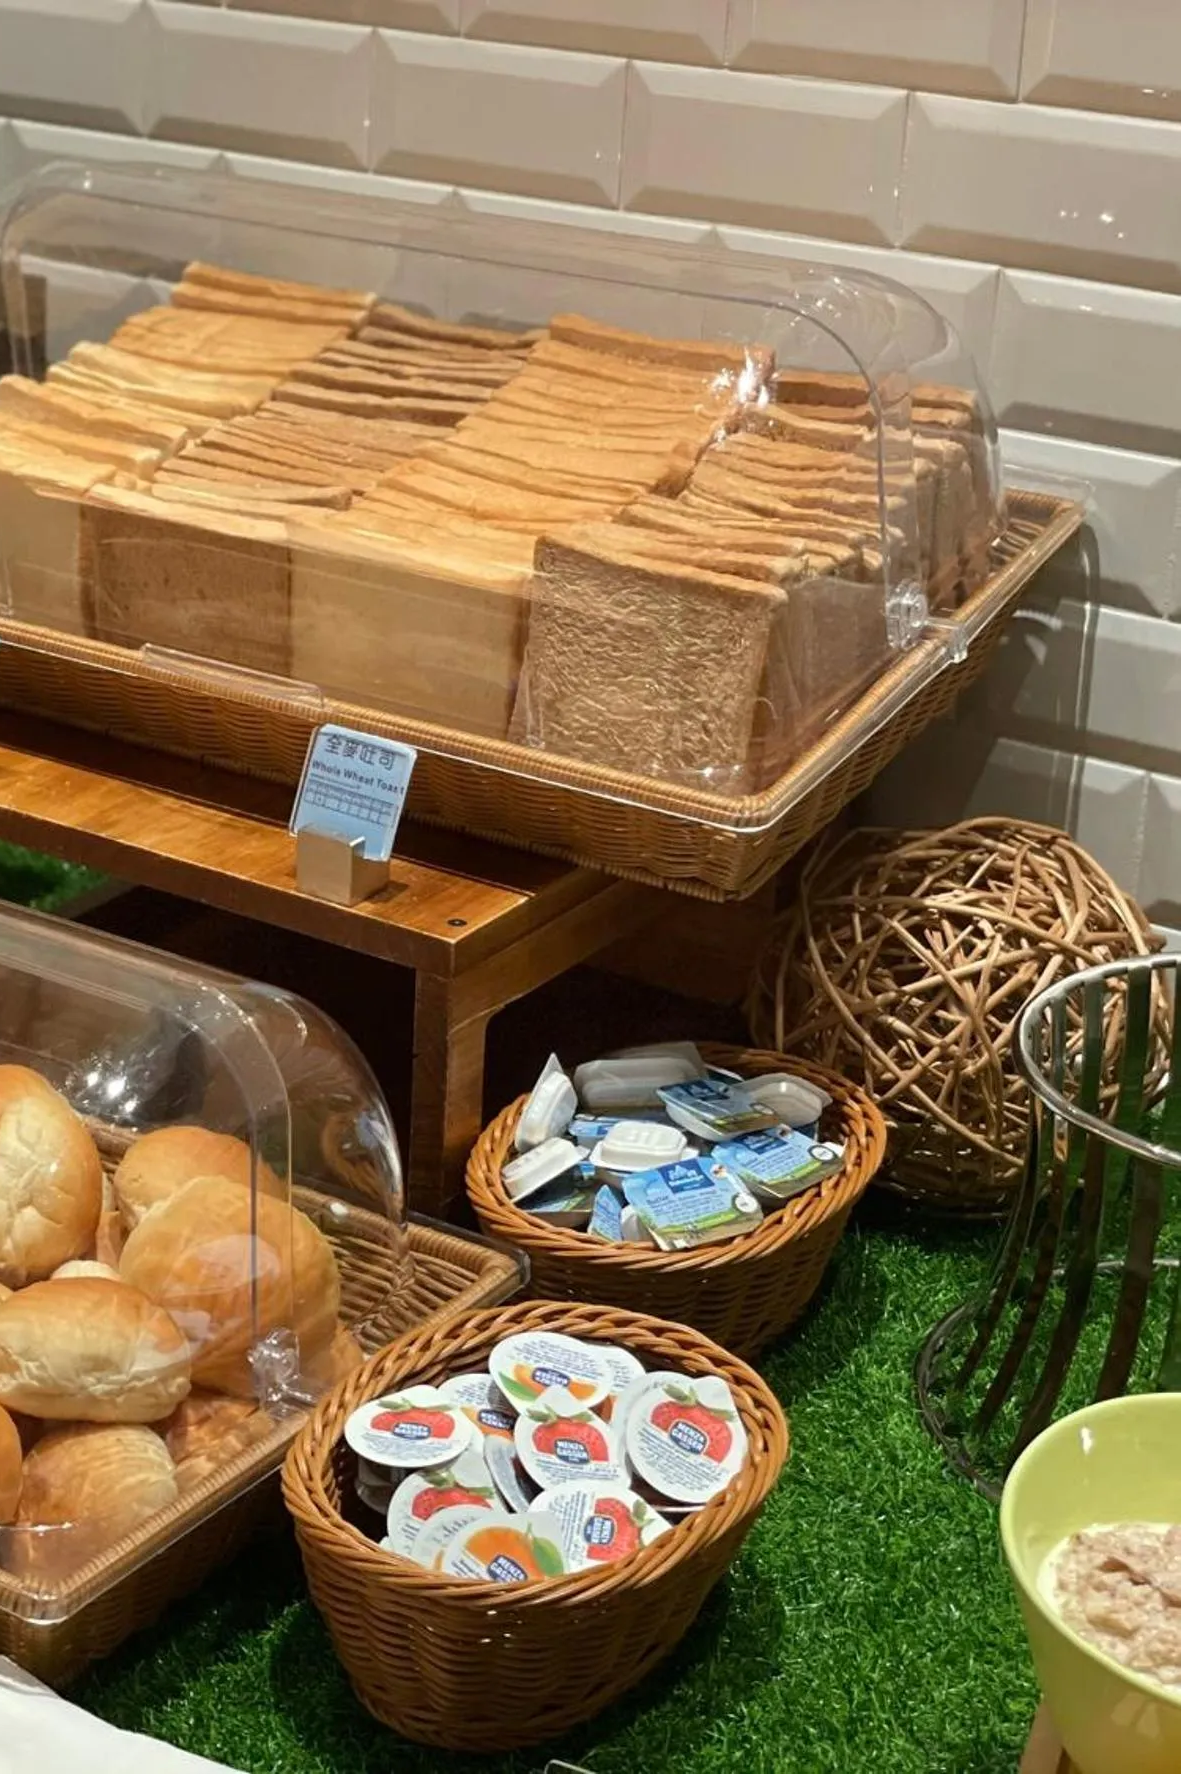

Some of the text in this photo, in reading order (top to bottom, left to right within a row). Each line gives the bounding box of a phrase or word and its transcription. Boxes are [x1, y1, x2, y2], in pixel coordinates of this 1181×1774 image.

[324, 734, 395, 771] 全麥吐司
[312, 759, 341, 776] Whole
[343, 768, 375, 787] Wheat
